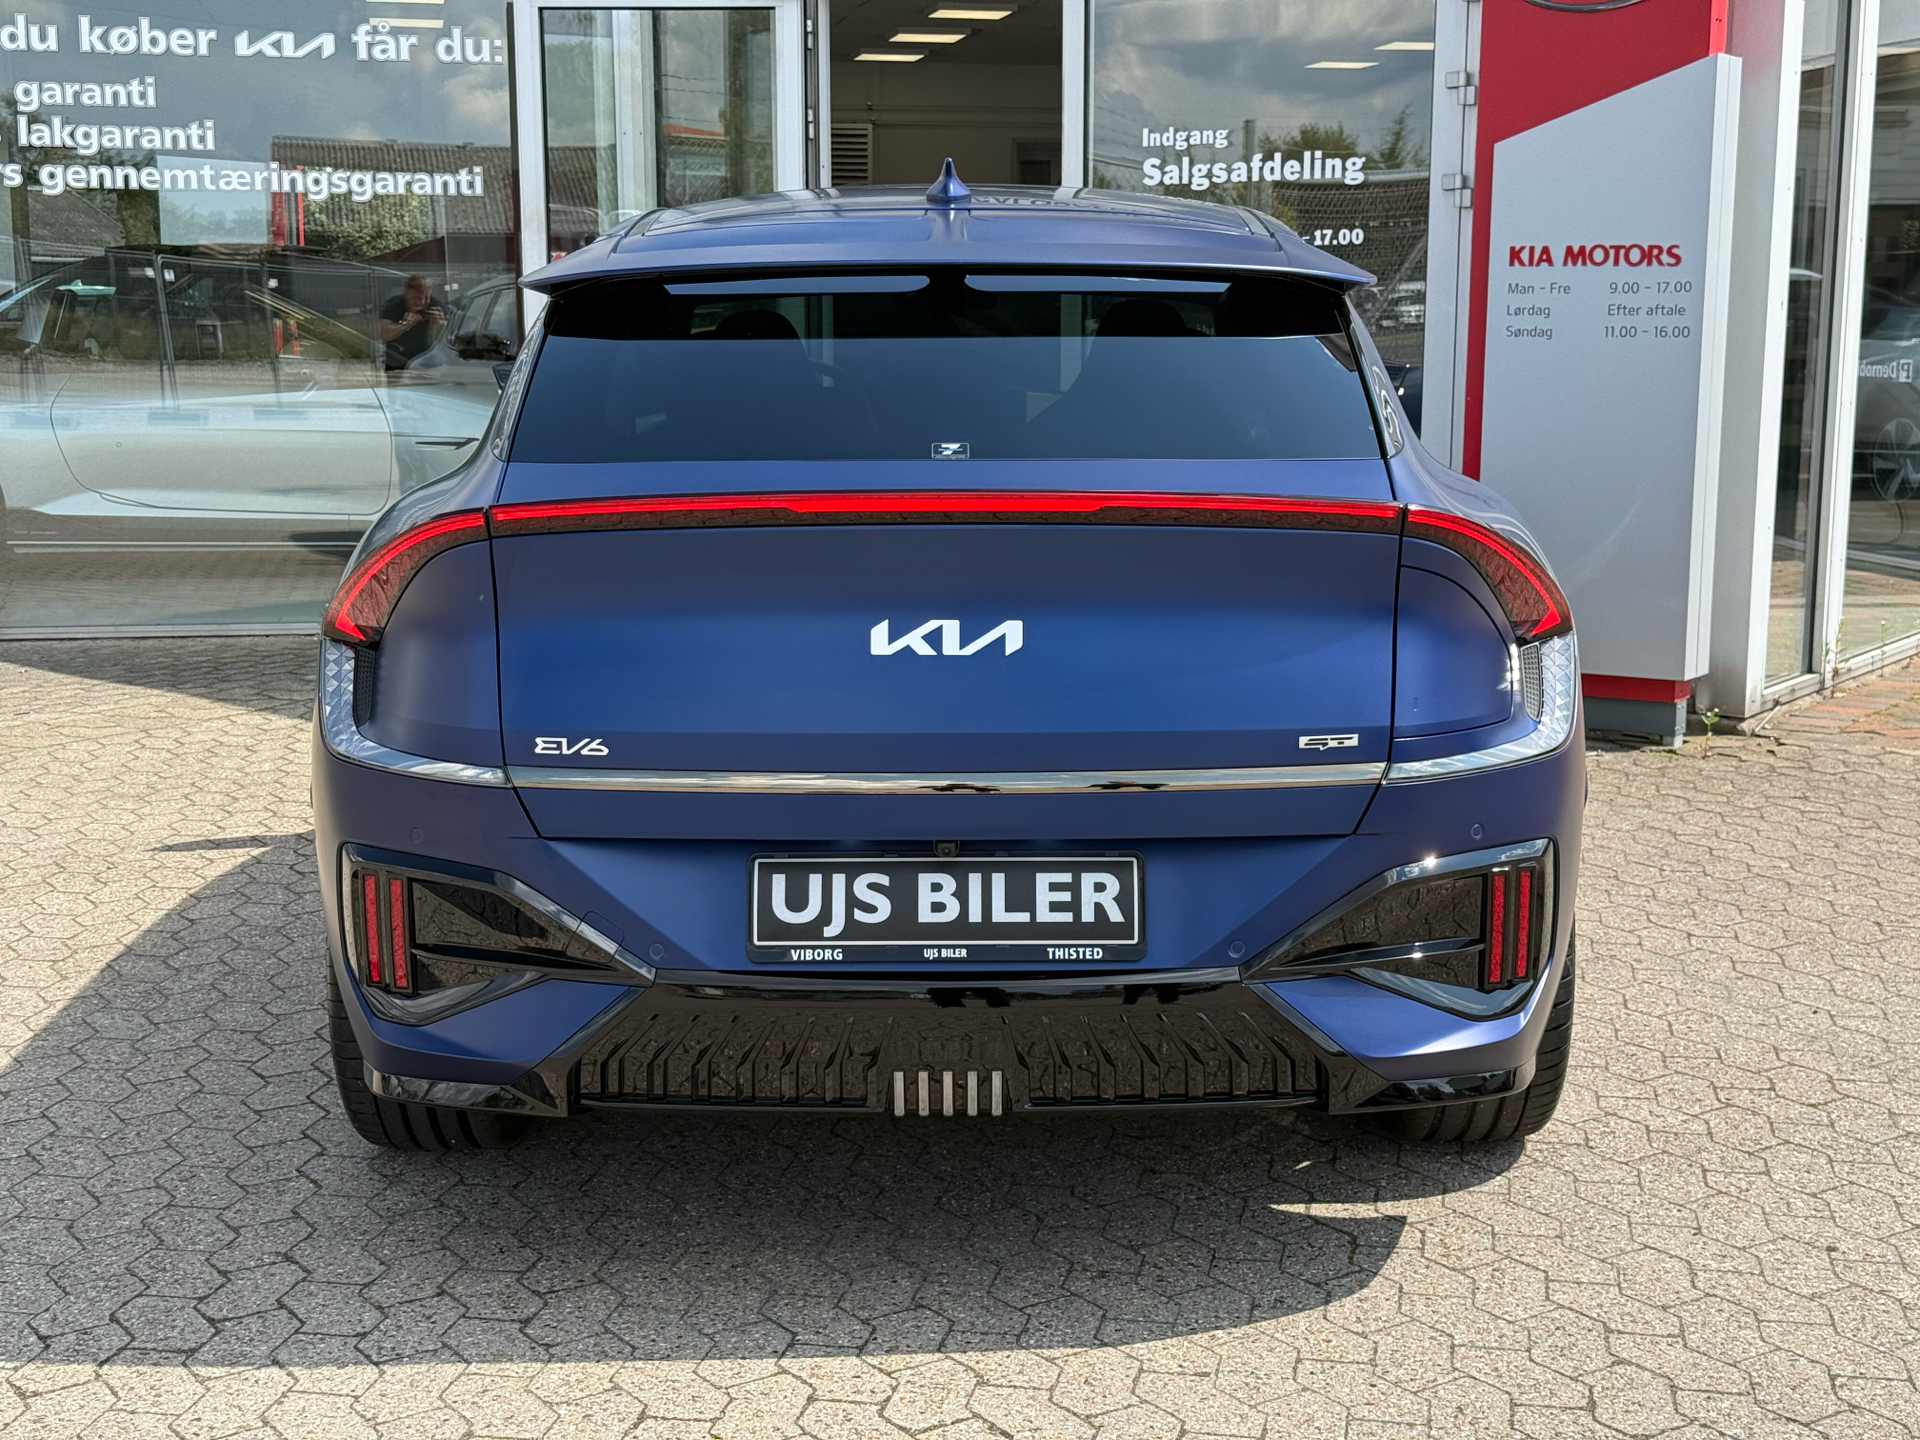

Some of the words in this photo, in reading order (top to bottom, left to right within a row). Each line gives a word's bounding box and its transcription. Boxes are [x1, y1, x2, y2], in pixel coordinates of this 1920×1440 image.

[0, 13, 58, 52] du
[78, 15, 217, 57] køber
[235, 31, 336, 59] KIA
[352, 20, 418, 62] får
[435, 26, 503, 64] du:
[13, 76, 157, 112] garanti
[17, 115, 215, 156] lakgaranti
[1142, 127, 1229, 150] Indgang
[1142, 151, 1366, 190] Salgsafdeling
[40, 162, 484, 201] gennemtæringsgaranti
[1313, 228, 1365, 246] 17.00
[1508, 245, 1554, 267] KIA
[1563, 244, 1682, 267] MOTORS
[1507, 282, 1536, 295] Man
[1550, 282, 1571, 295] Fre
[1609, 281, 1640, 295] 9.00
[1656, 281, 1692, 294] 17.00
[1506, 304, 1551, 320] Lørdag
[1607, 303, 1642, 317] Efter
[1646, 303, 1686, 317] aftale
[1505, 325, 1553, 341] Søndag
[1604, 325, 1637, 339] 11.00
[1653, 325, 1690, 339] 16.00
[870, 619, 1024, 656] KIA
[535, 737, 609, 756] EV6
[771, 872, 892, 937] UJS
[917, 872, 1126, 923] BILER
[791, 949, 843, 961] VIBORG
[923, 948, 938, 960] UJS
[941, 948, 967, 958] BILER
[1047, 948, 1103, 959] THISTED
